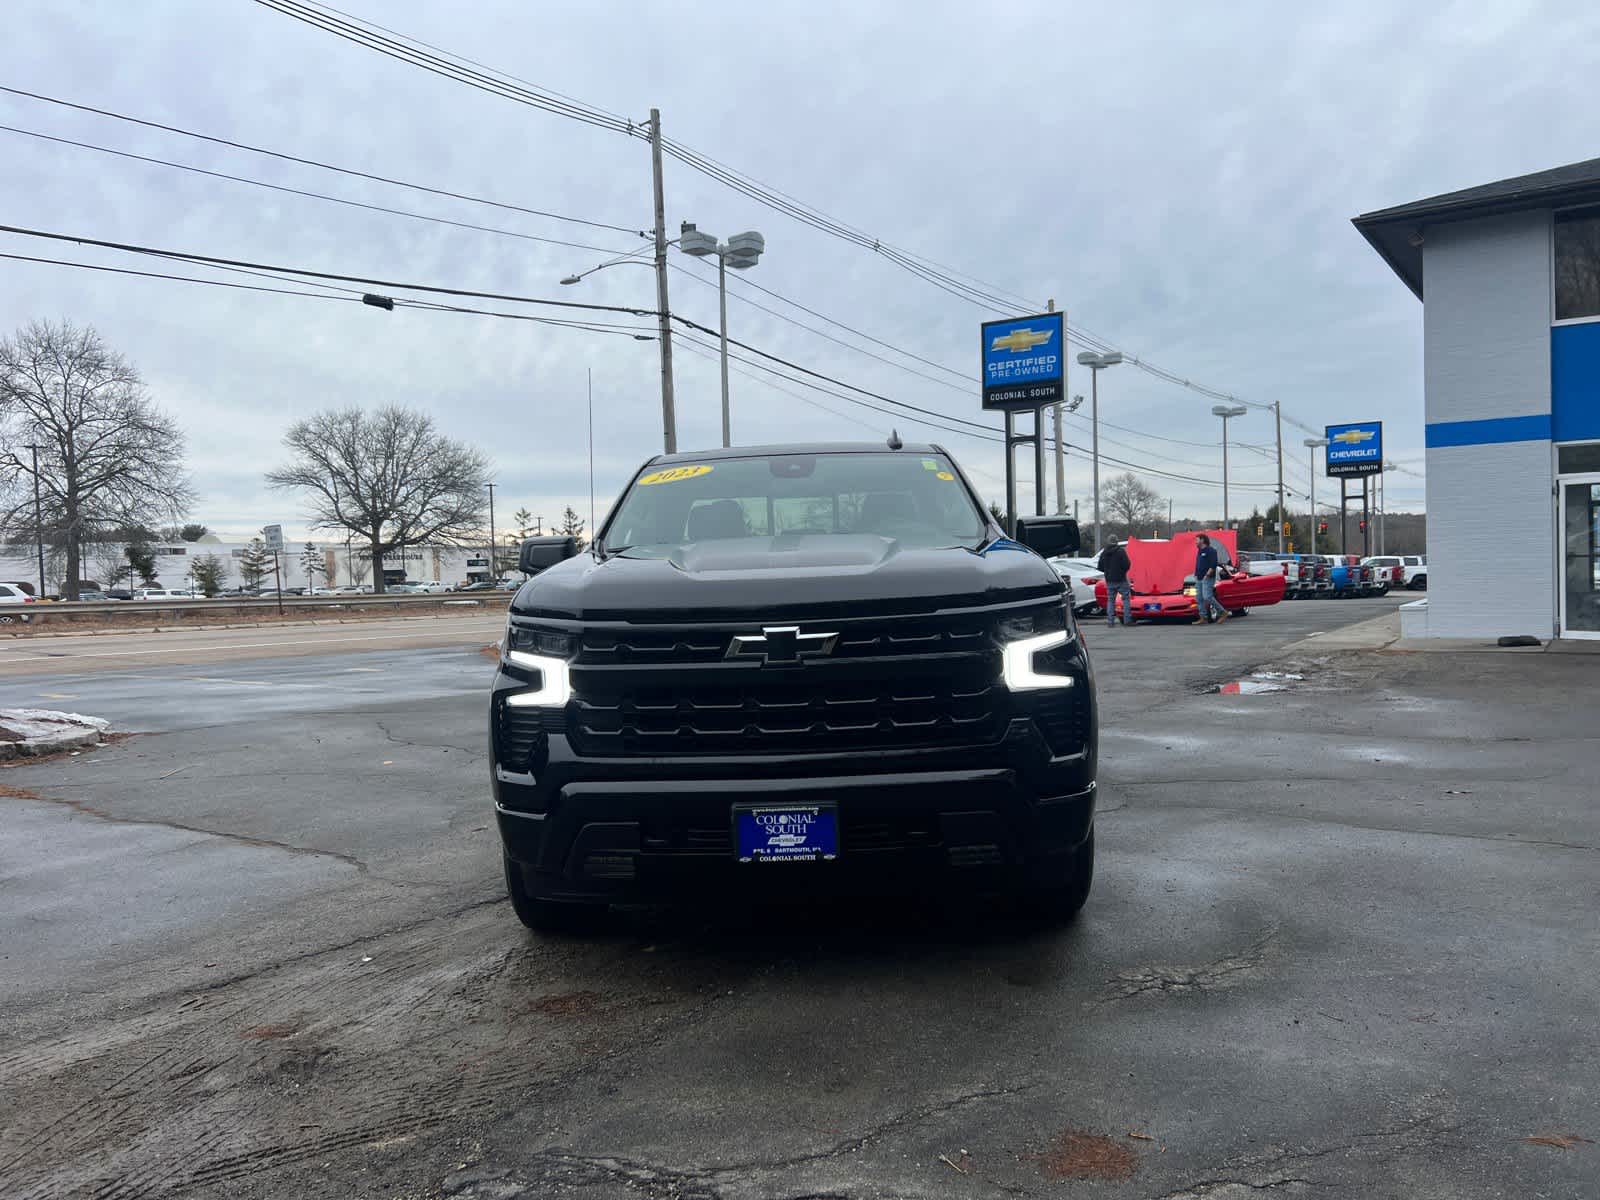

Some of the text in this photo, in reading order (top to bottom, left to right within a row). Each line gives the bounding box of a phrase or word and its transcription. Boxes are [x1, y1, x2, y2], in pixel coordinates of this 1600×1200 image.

[988, 355, 1057, 371] CERTIFIED
[990, 387, 1056, 401] COLONIAL SOUTH
[1330, 448, 1377, 459] CHEVROLET
[756, 814, 816, 825] COLONIAL
[765, 824, 807, 834] SOUTH
